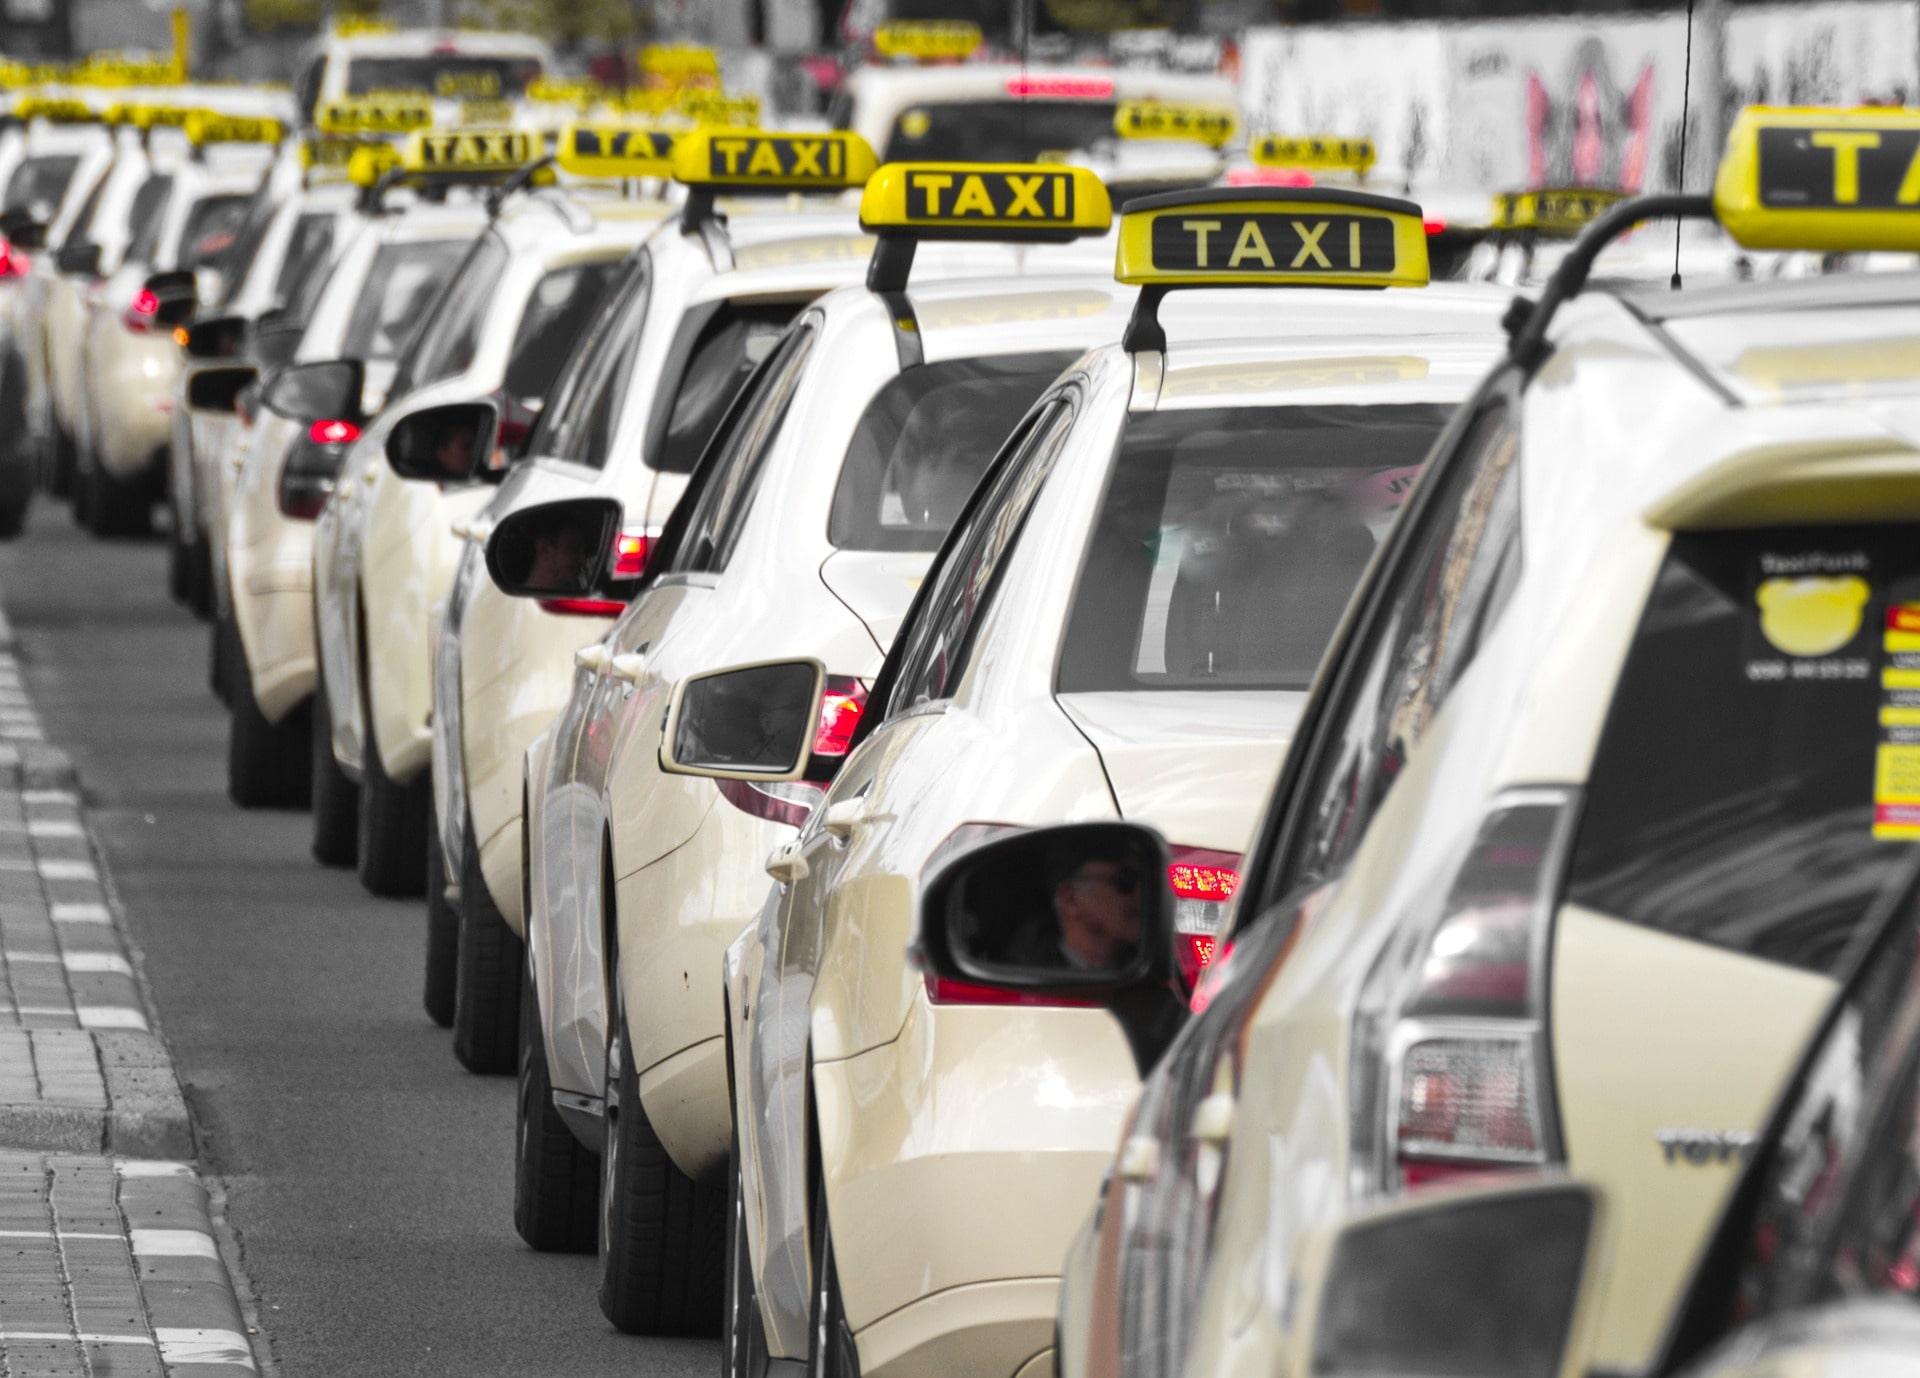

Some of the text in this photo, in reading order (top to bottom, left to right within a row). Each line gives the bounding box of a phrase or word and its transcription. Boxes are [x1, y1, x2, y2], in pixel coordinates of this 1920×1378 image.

[426, 136, 522, 162] TAXI
[714, 139, 843, 176] TAXI
[912, 174, 1067, 217] TAXI
[1182, 220, 1361, 269] TAXI
